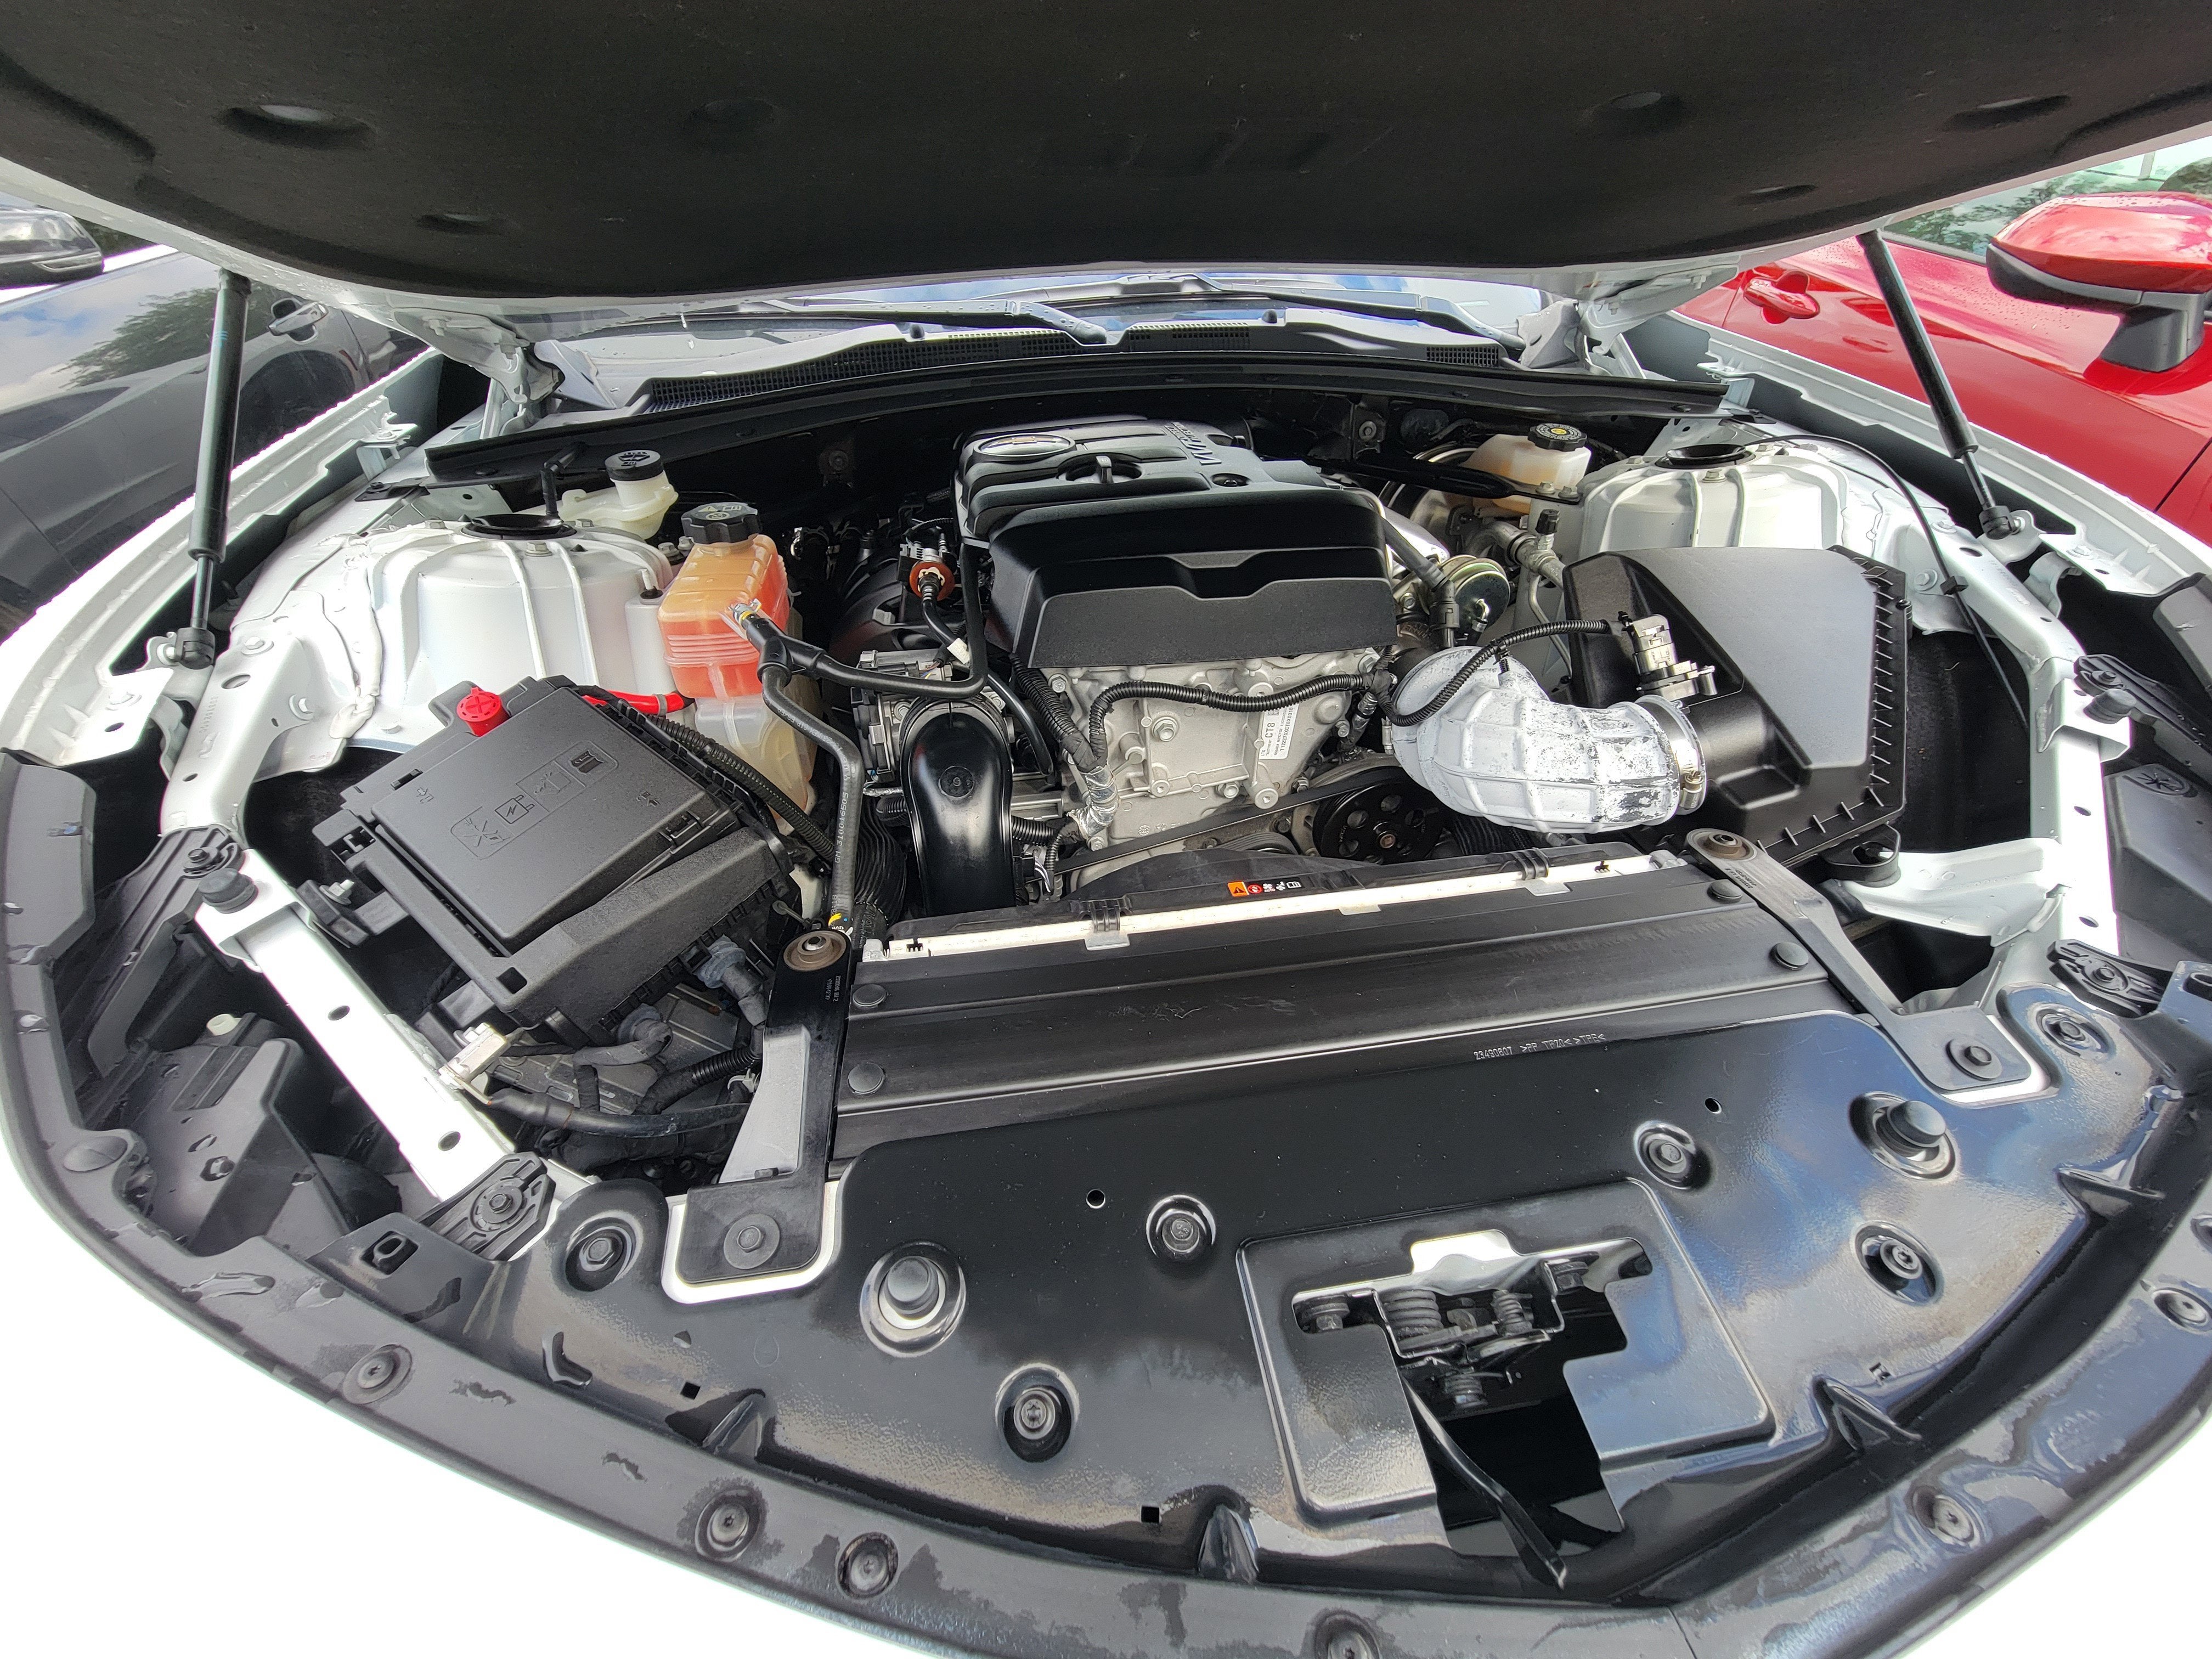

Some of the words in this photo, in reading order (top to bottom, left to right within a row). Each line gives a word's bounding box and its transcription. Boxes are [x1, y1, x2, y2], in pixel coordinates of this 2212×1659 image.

[1265, 723, 1276, 738] CT8
[834, 850, 842, 863] GM
[1473, 1046, 1513, 1060] 23490807
